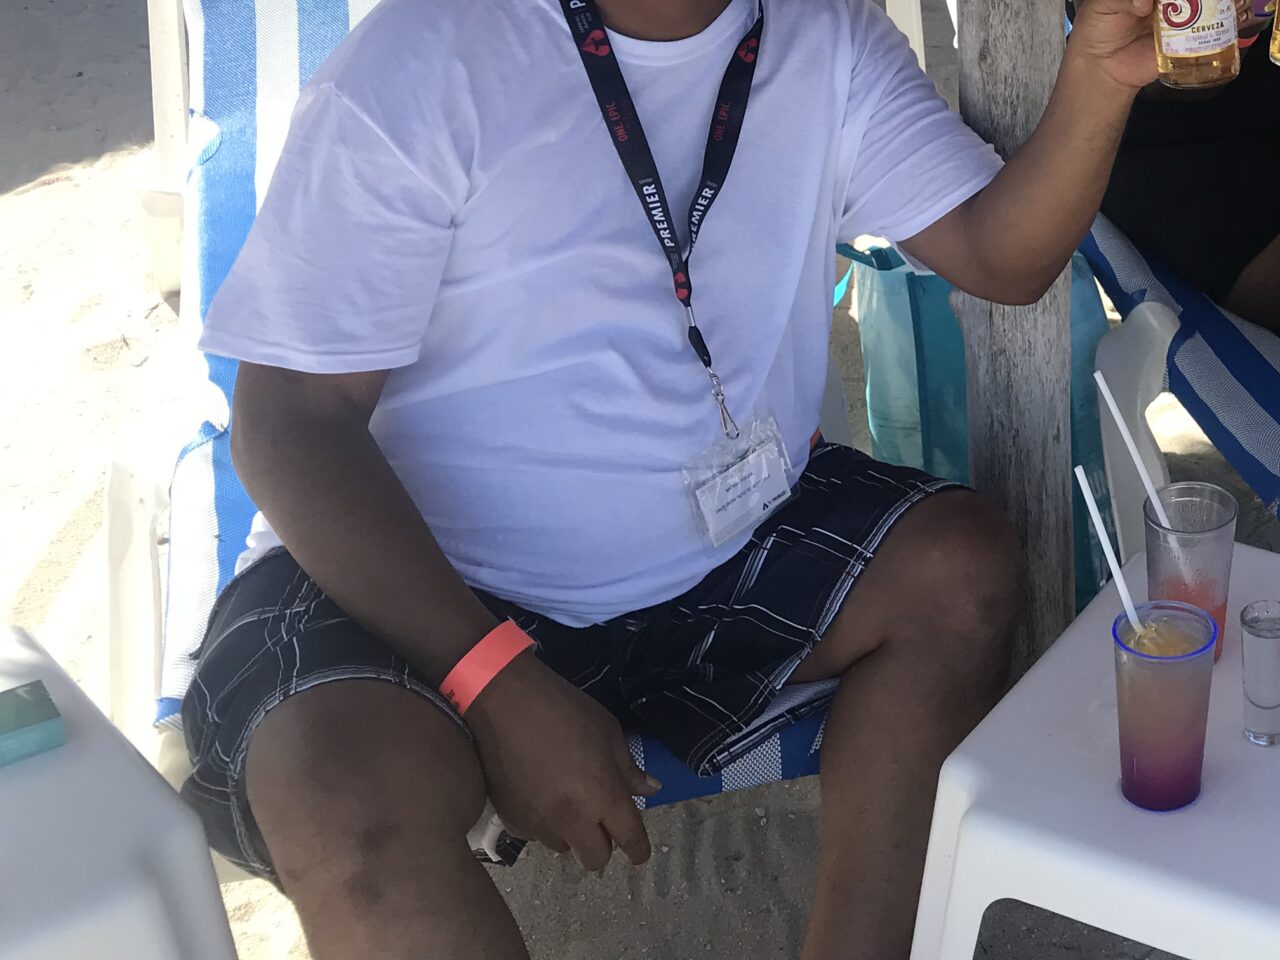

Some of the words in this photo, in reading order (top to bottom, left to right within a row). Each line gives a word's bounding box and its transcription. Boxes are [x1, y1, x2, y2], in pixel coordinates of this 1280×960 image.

[1191, 21, 1225, 34] CERVEZA
[606, 101, 621, 121] EPIC
[719, 101, 732, 121] EPIC
[614, 122, 628, 142] ONE
[713, 123, 726, 141] ONE
[642, 183, 676, 247] PREMIER
